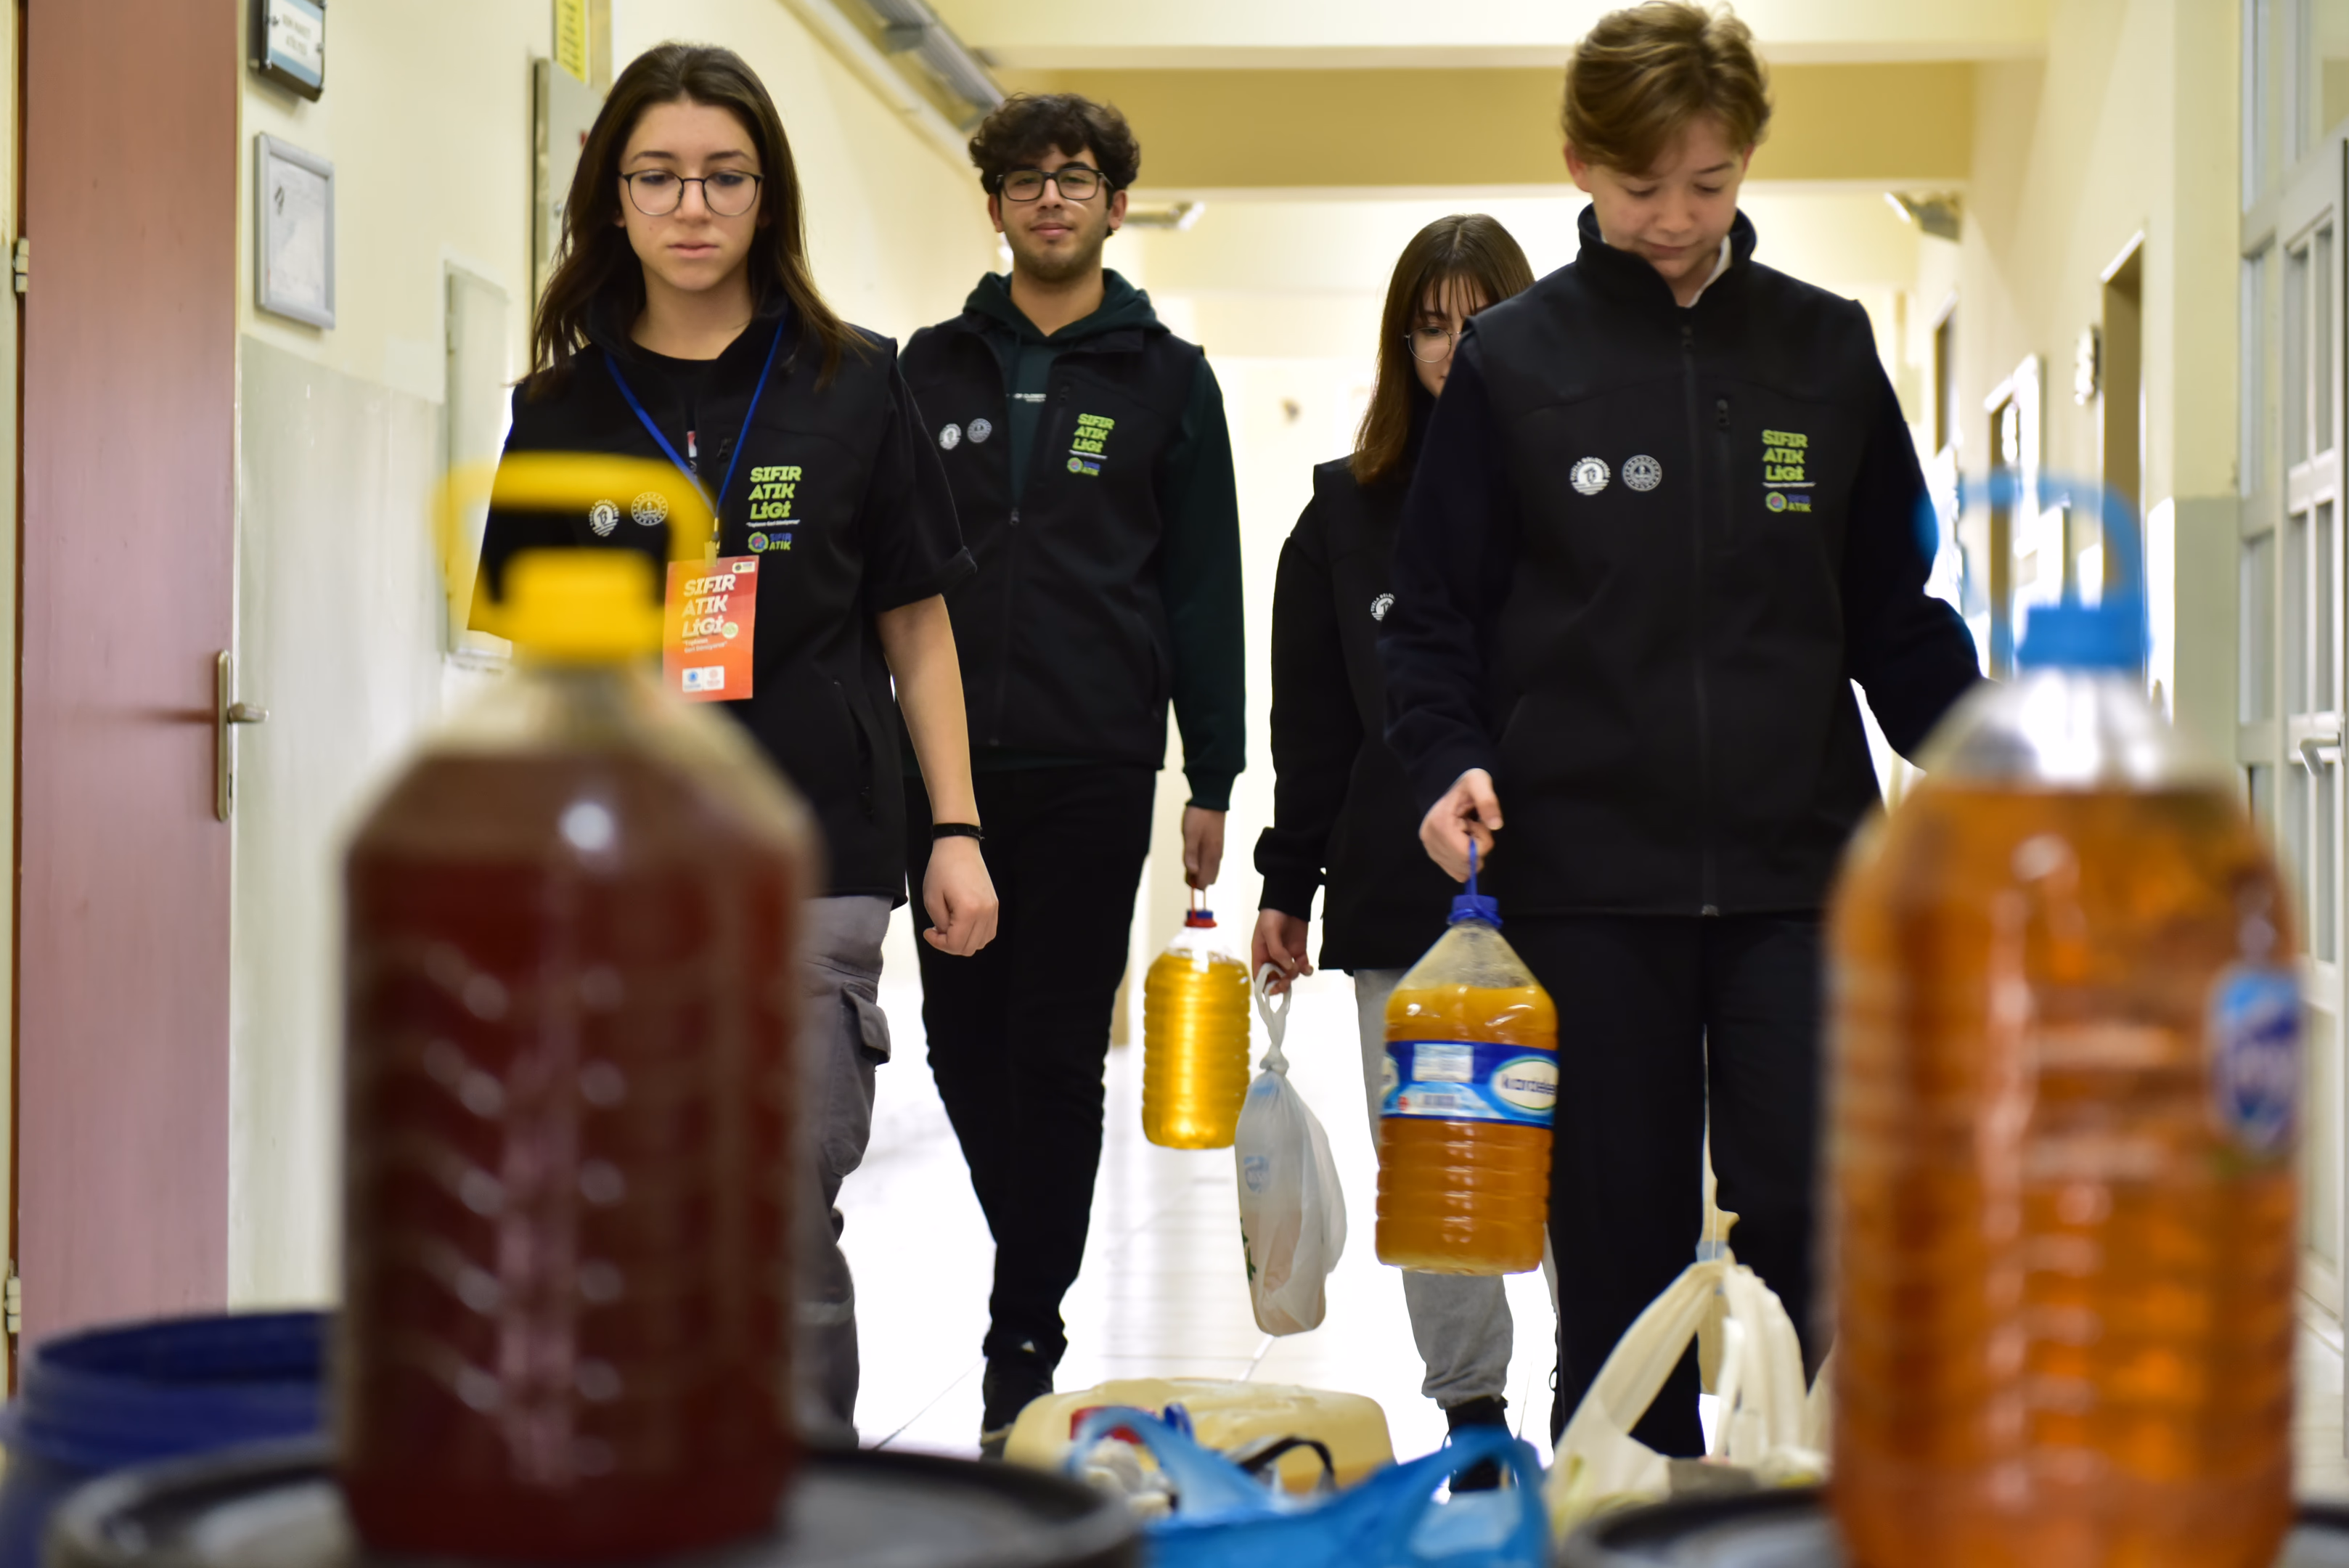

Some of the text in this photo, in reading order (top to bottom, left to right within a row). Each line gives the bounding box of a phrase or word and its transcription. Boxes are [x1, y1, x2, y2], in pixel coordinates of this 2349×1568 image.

[1078, 413, 1115, 430] SIFIR
[1074, 425, 1108, 441] ATIK
[1762, 430, 1808, 448] SIFIR
[1762, 448, 1805, 464] ATIK
[750, 466, 802, 483] SIFIR
[748, 483, 796, 500] ATIK
[750, 500, 791, 520] LİGİ
[768, 541, 791, 551] ATIK
[683, 573, 736, 597] SIFIR
[682, 594, 729, 617] ATIK
[1370, 597, 1380, 612] TUZLA
[681, 615, 724, 640] LİGİ
